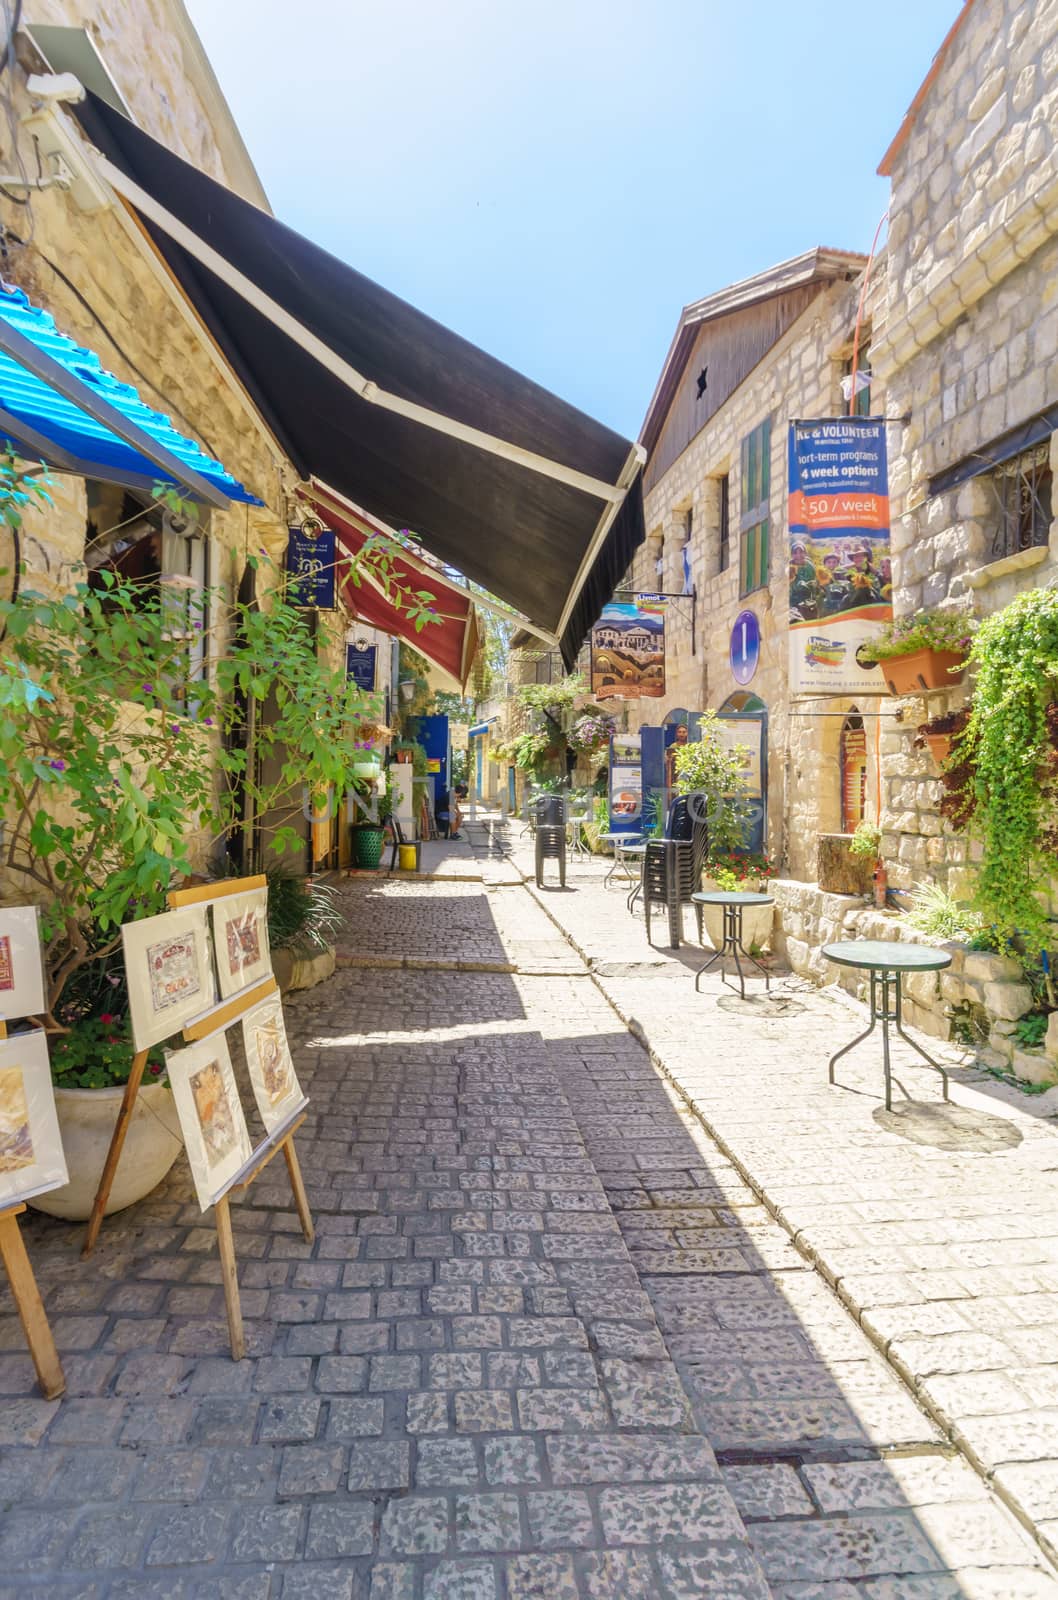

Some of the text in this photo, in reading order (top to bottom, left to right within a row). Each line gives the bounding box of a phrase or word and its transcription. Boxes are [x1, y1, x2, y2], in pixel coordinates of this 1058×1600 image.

[822, 426, 879, 438] VOLUNTEER
[840, 451, 878, 463] programs
[801, 465, 878, 479] 4 week options
[842, 498, 877, 512] week
